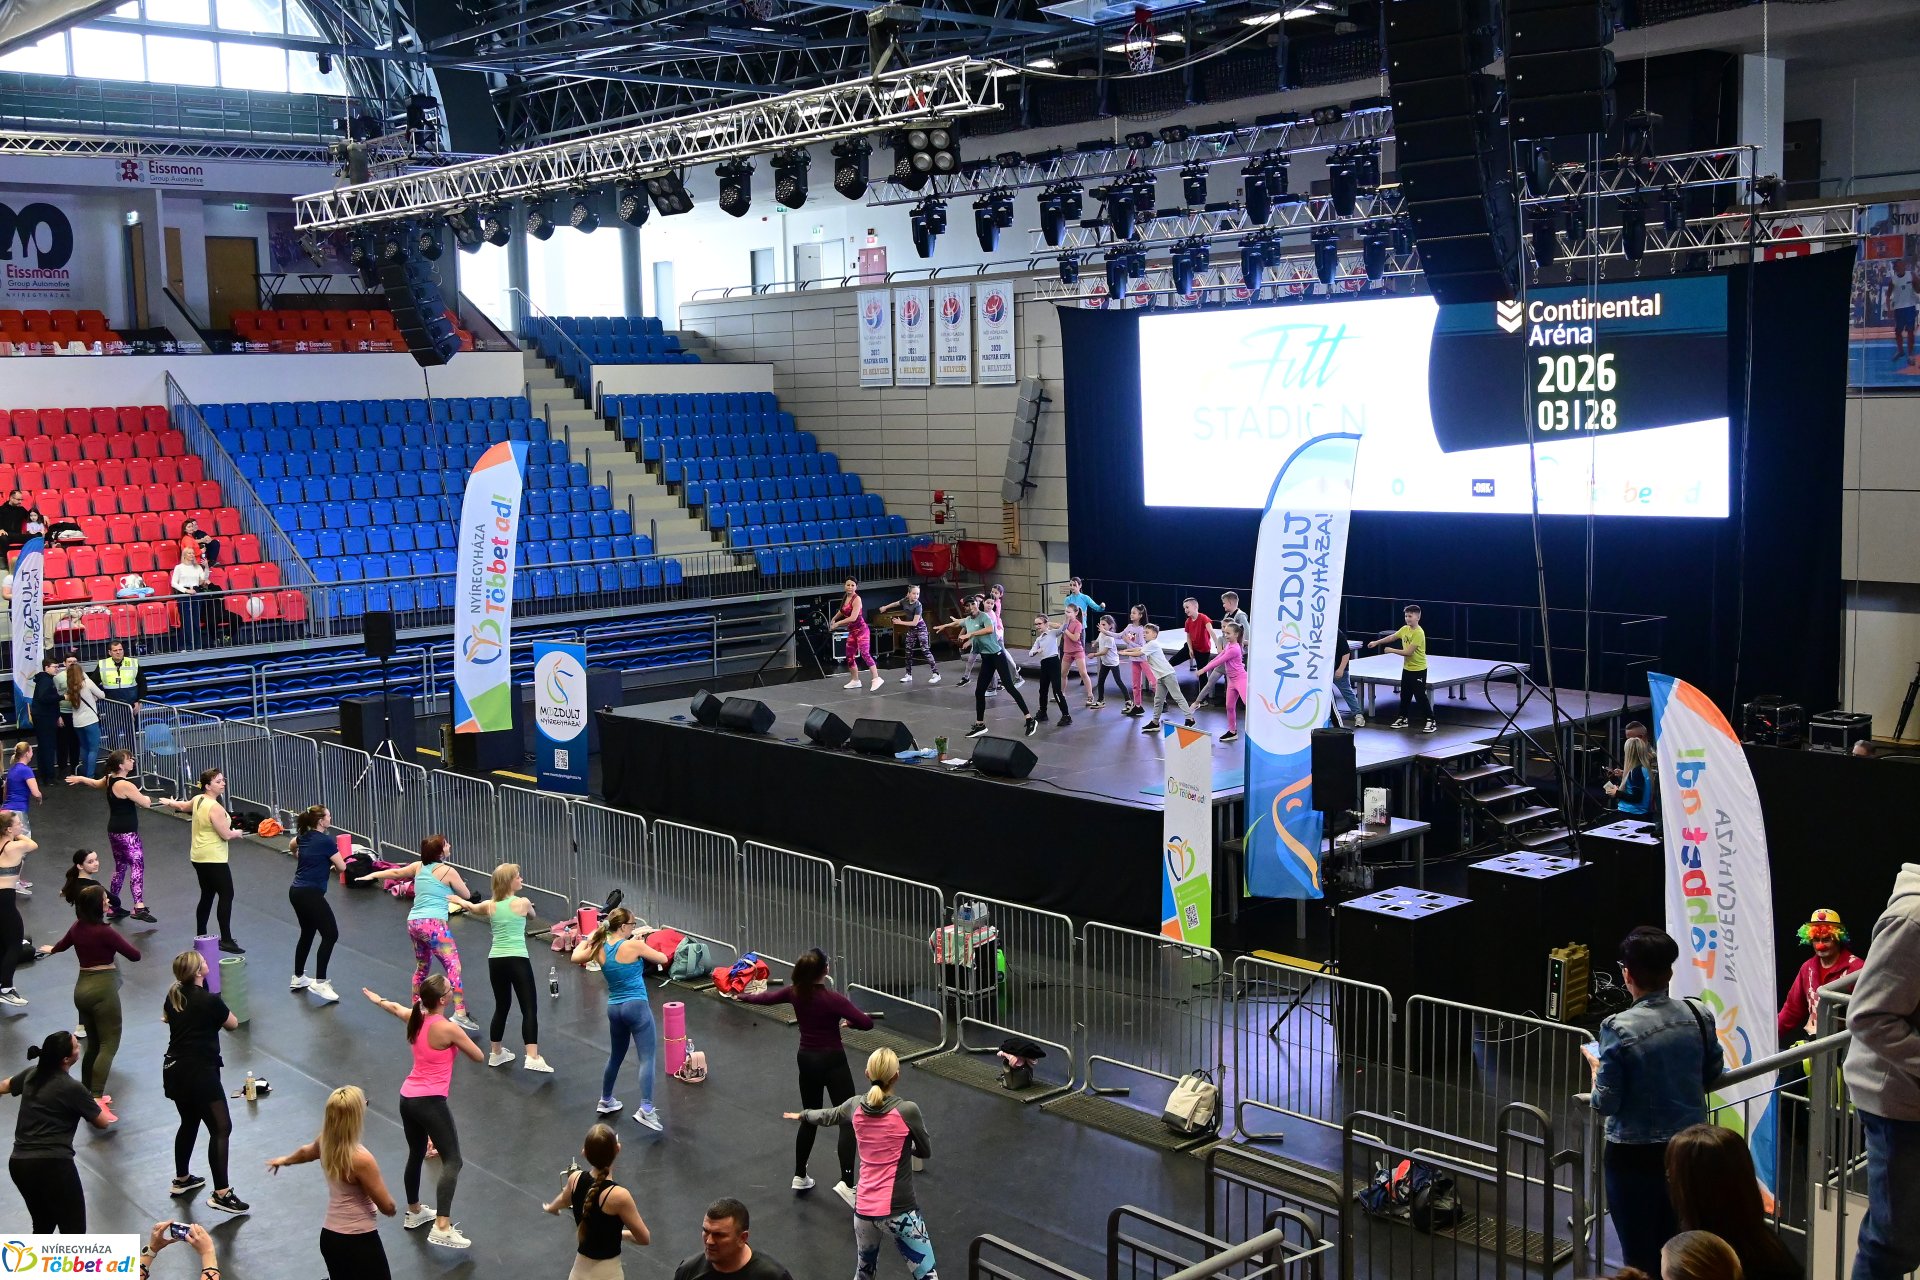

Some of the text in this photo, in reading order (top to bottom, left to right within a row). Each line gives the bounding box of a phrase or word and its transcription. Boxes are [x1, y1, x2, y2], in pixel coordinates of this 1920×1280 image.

[148, 160, 203, 175] Eissmann
[172, 175, 204, 183] Automotive
[6, 264, 70, 279] Eissmann
[8, 280, 70, 288] Group Automotive
[1528, 293, 1661, 322] Continental
[1529, 323, 1593, 347] Aréna
[1537, 353, 1617, 393] 2026
[485, 493, 513, 614] Többet ad!
[470, 523, 486, 614] NYÍREGYHÁZA
[1274, 511, 1311, 679] MOZDULJ
[1307, 513, 1334, 680] NYÍREGYHÁZA!
